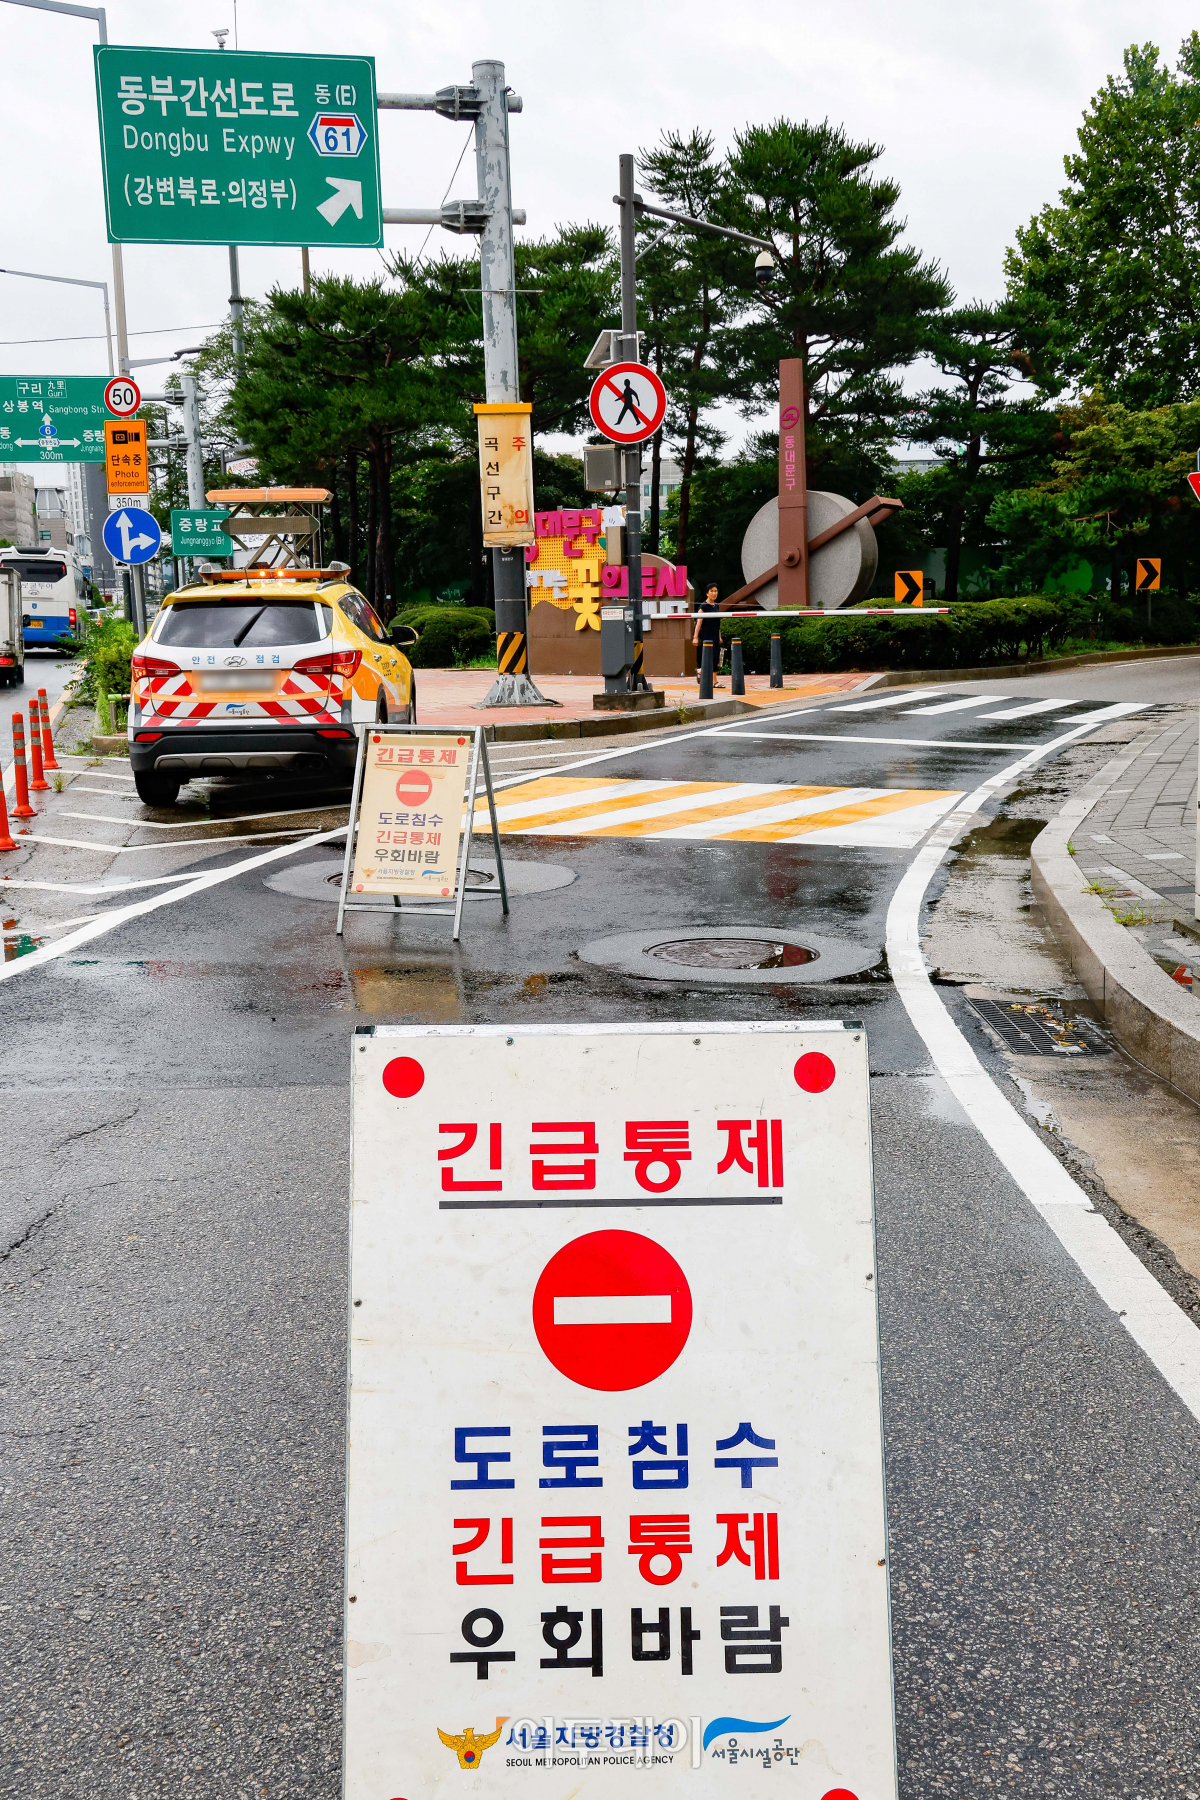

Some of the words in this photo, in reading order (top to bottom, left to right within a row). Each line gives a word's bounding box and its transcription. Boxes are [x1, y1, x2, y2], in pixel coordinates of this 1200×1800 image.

[117, 75, 299, 118] 동부간선도로
[123, 124, 209, 157] Dongbu
[223, 128, 296, 160] Expwy
[324, 126, 352, 152] 61
[124, 174, 297, 210] (강변북로·의정부)
[18, 382, 42, 394] 구리
[48, 381, 65, 390] 九里
[112, 388, 134, 406] 50
[2, 400, 44, 413] 상봉역
[48, 405, 88, 415] Sangbong
[92, 405, 104, 414] Stn
[44, 426, 51, 434] 6
[40, 452, 64, 460] 300m
[112, 454, 142, 466] 단속중
[785, 436, 796, 490] 동대문구
[115, 470, 140, 478] Photo
[116, 498, 142, 508] 350m
[192, 655, 216, 666] 안전
[255, 654, 280, 664] 점검
[376, 748, 458, 764] 긴급통제
[378, 812, 444, 828] 도로침수
[376, 830, 442, 846] 긴급통제
[374, 848, 440, 864] 우회바람
[437, 1118, 784, 1193] 긴급통제
[450, 1420, 779, 1491] 도로침수
[452, 1512, 780, 1586] 긴급통제
[450, 1604, 790, 1680] 우회바람
[506, 1723, 675, 1750] 서울지방경찰청
[711, 1738, 801, 1768] 서울시설공단
[506, 1759, 532, 1768] SEOUL
[535, 1757, 600, 1767] METROPOLITAN
[603, 1756, 635, 1766] POLICE
[636, 1755, 674, 1766] AGENCY
